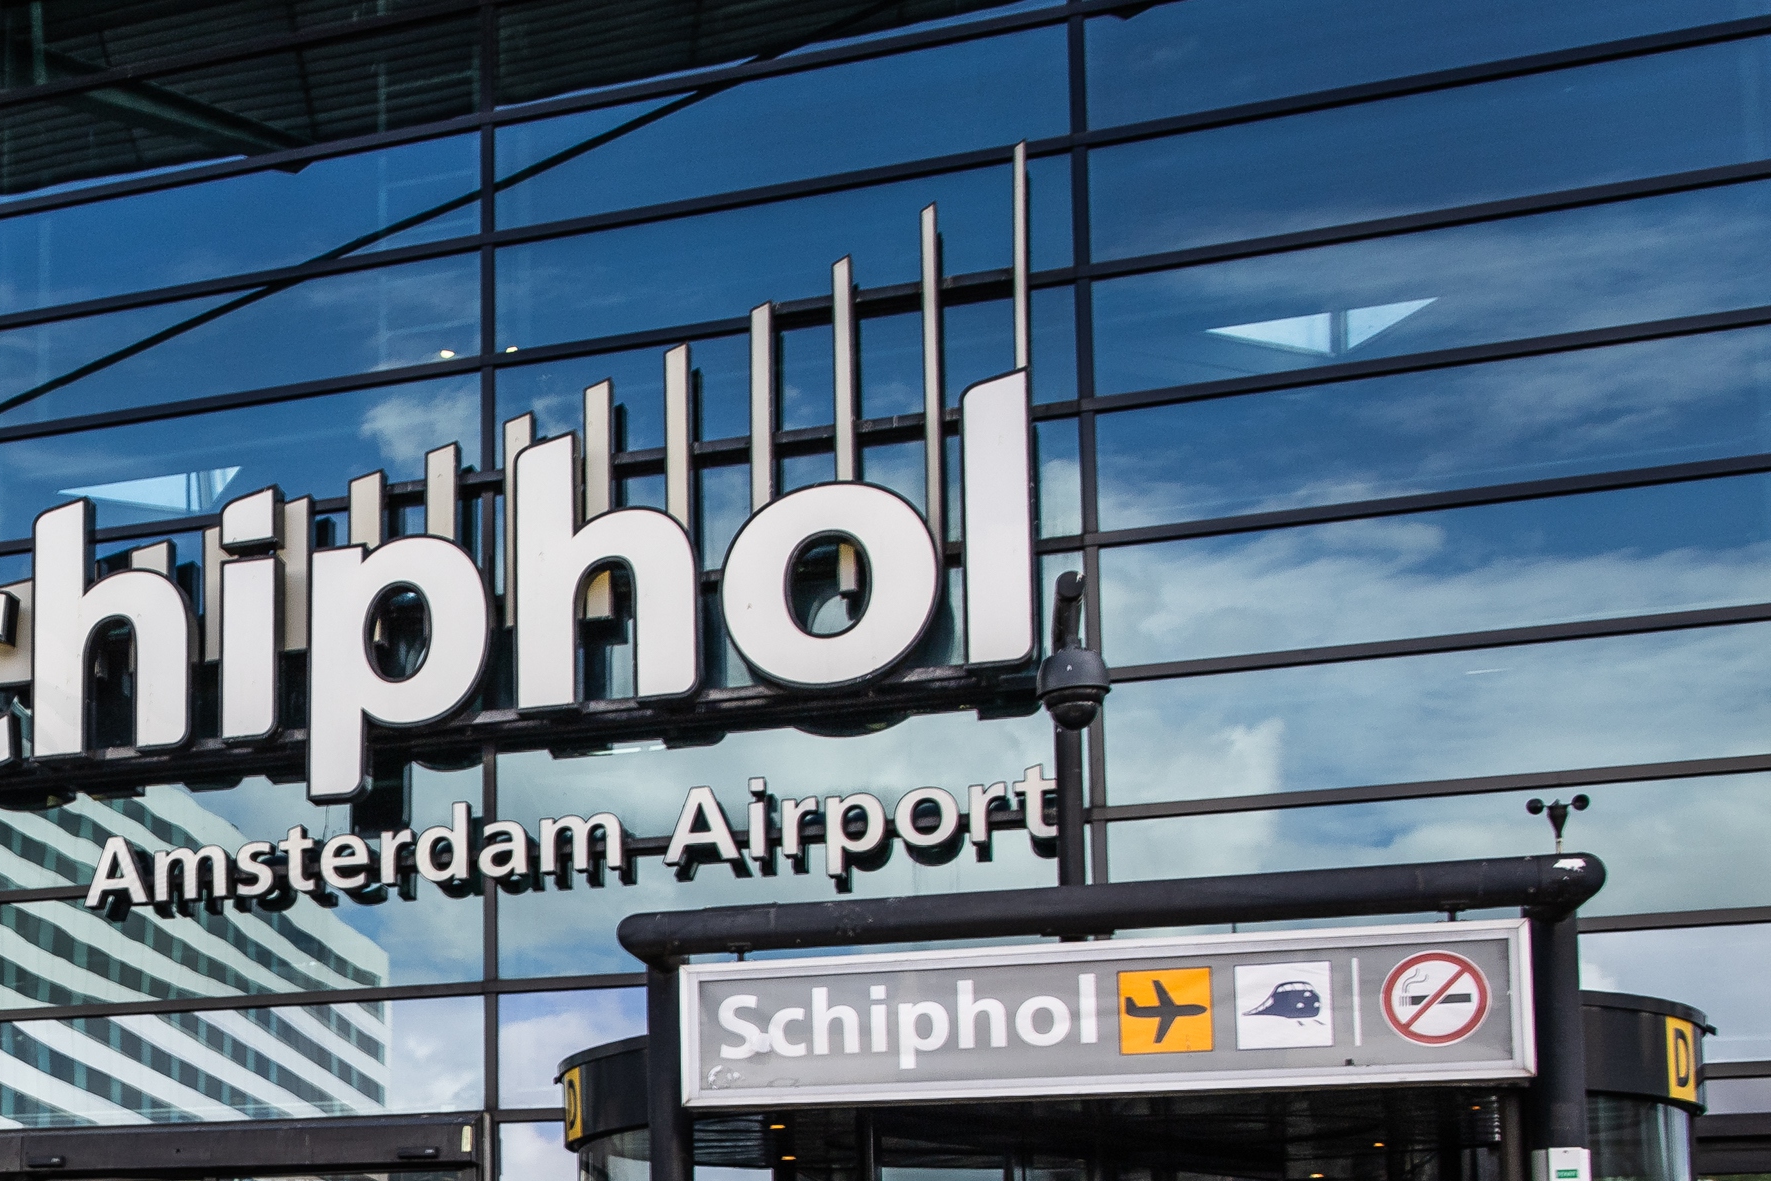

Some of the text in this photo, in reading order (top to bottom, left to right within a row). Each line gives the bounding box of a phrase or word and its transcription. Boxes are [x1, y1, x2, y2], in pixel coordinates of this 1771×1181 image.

[84, 765, 1058, 908] Amsterdam Airport
[717, 972, 1099, 1070] Schiphol
[1674, 1027, 1690, 1088] D
